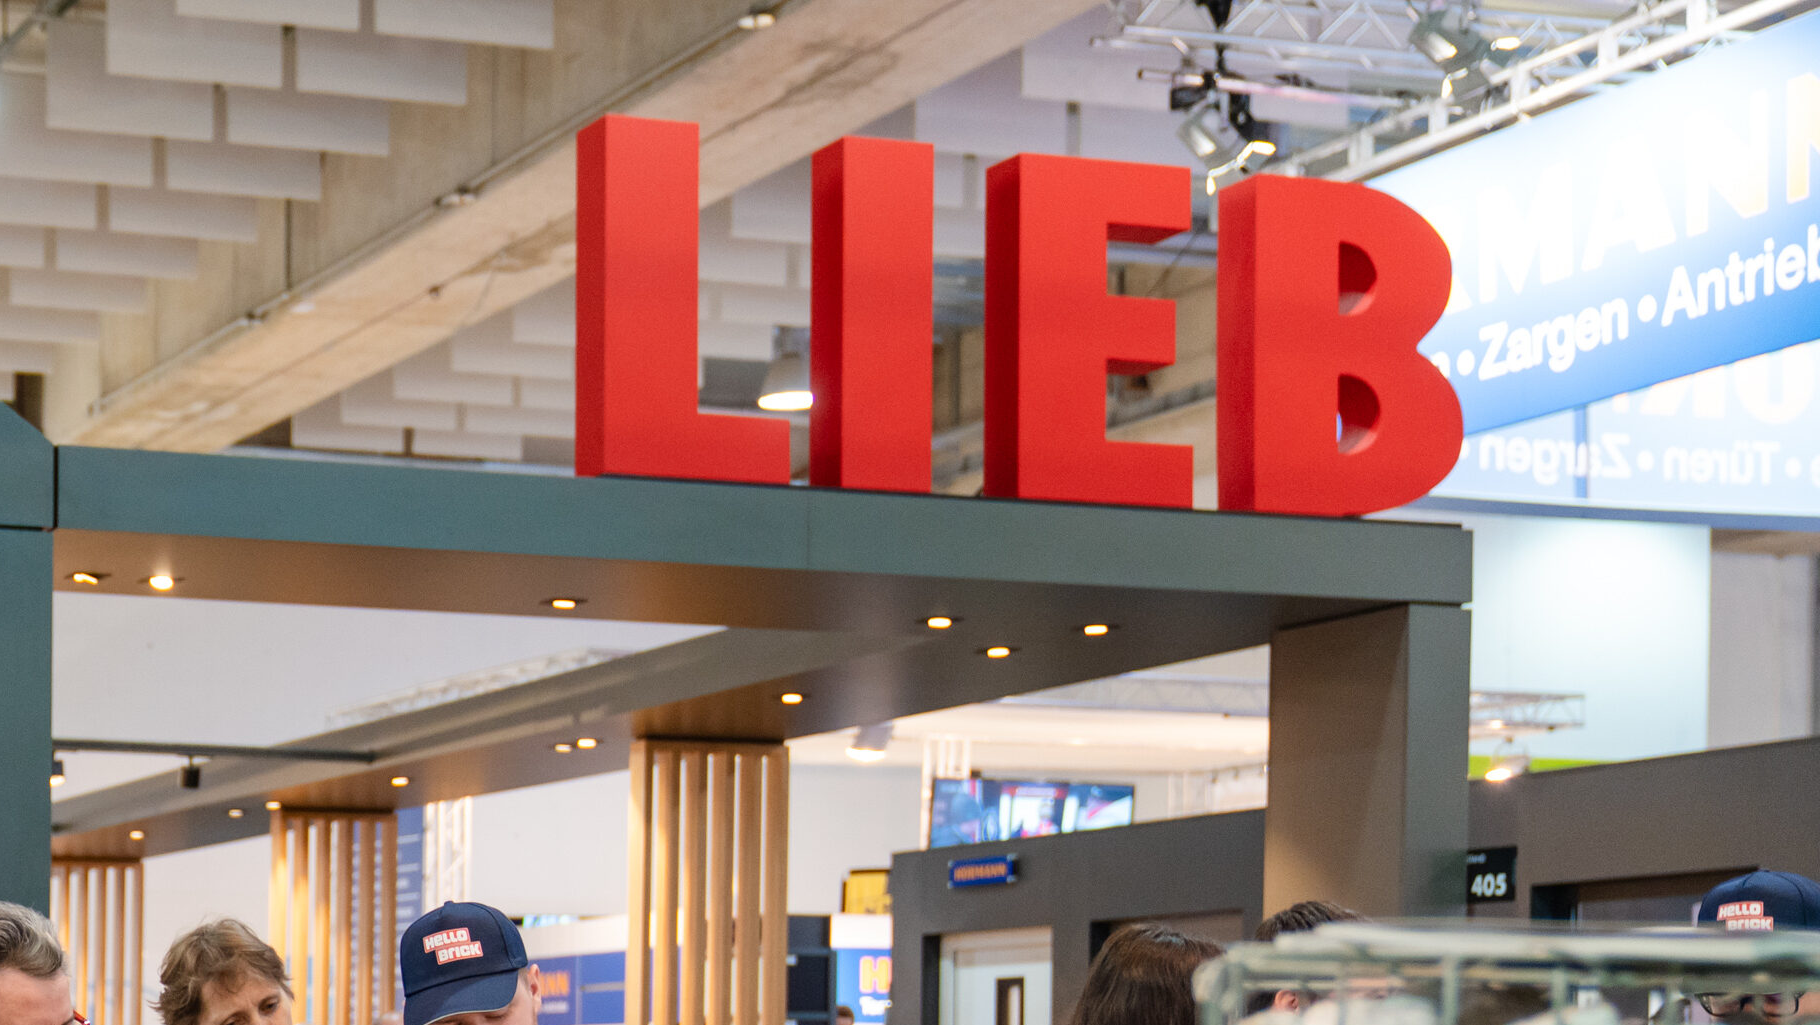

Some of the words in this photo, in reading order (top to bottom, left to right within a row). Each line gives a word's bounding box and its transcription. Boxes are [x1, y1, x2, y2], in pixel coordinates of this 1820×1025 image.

[576, 114, 1463, 518] LIEB
[1478, 297, 1629, 381] Zargen
[1471, 872, 1508, 897] 405
